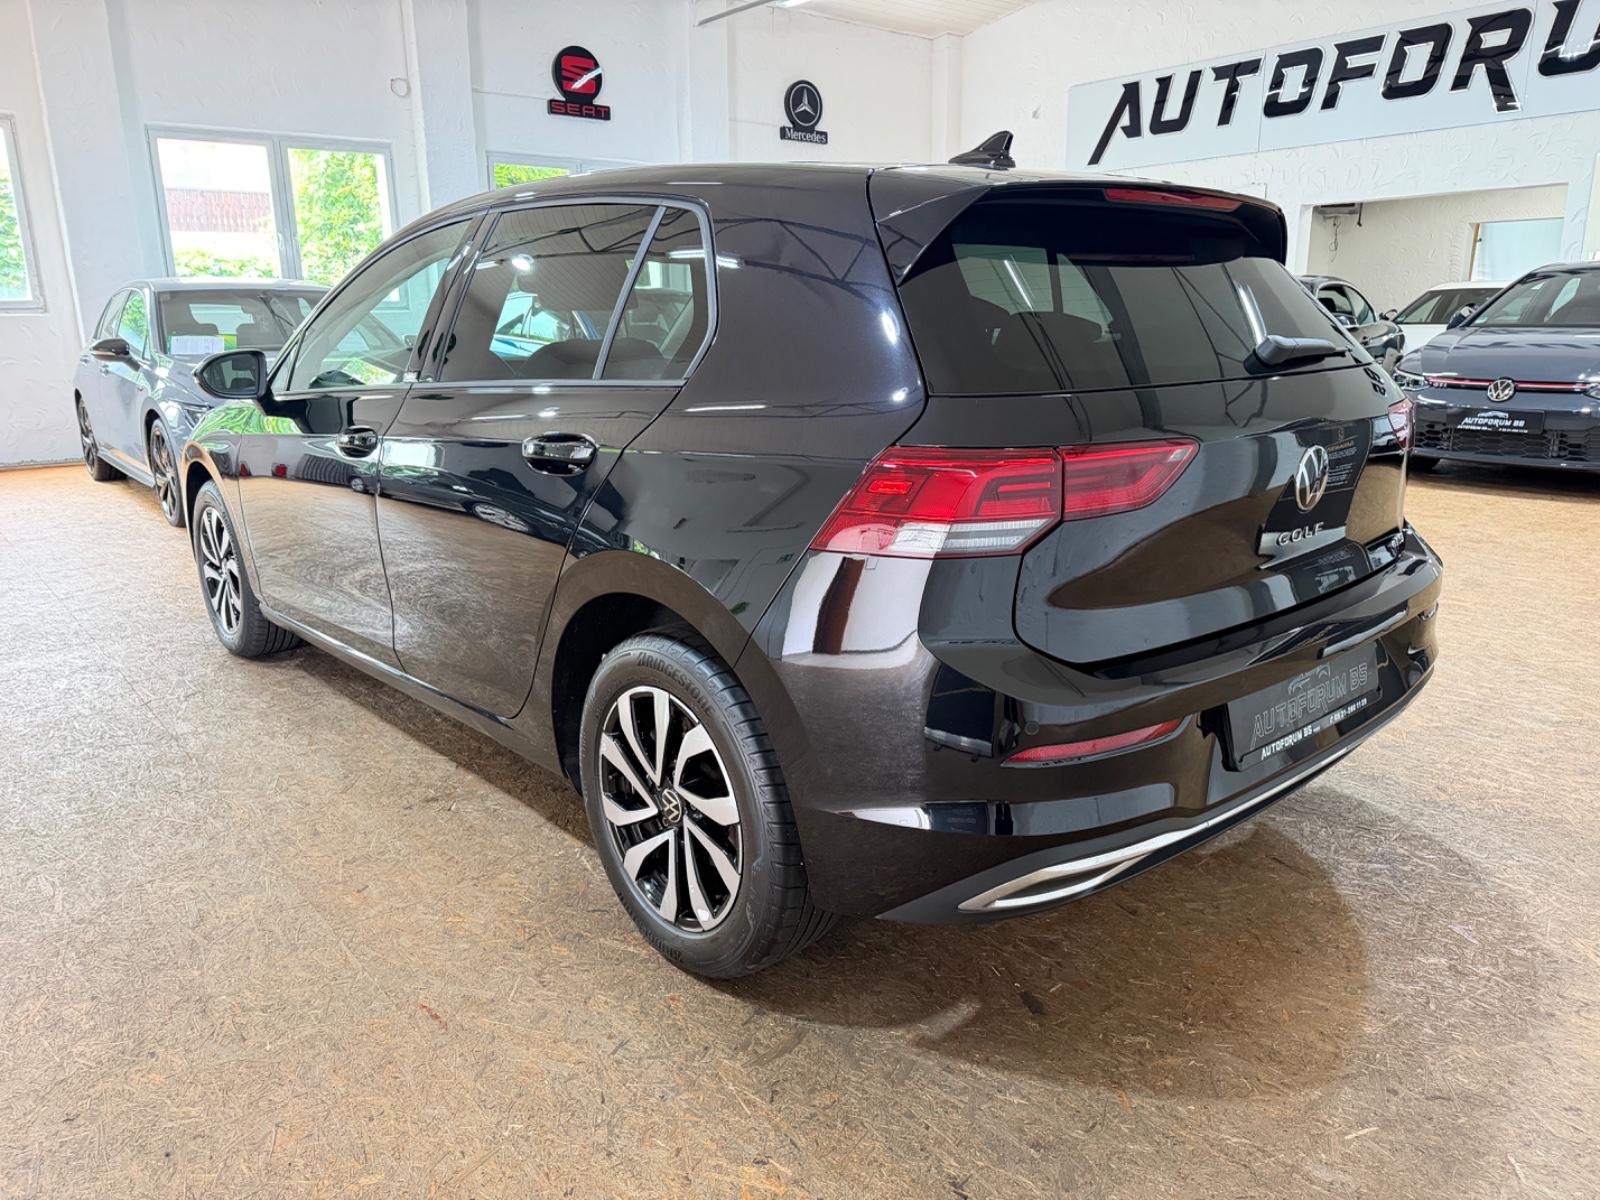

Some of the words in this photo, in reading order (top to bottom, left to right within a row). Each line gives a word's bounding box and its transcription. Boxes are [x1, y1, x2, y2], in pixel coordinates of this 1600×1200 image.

[551, 101, 609, 118] SEAT
[785, 127, 827, 143] Mercedes
[1461, 417, 1512, 427] AUTOFORUM
[1277, 521, 1325, 546] GOLF
[1250, 671, 1347, 751] AUTOFORUM
[1349, 662, 1368, 691] BS
[1261, 729, 1302, 760] AUTOFORUM
